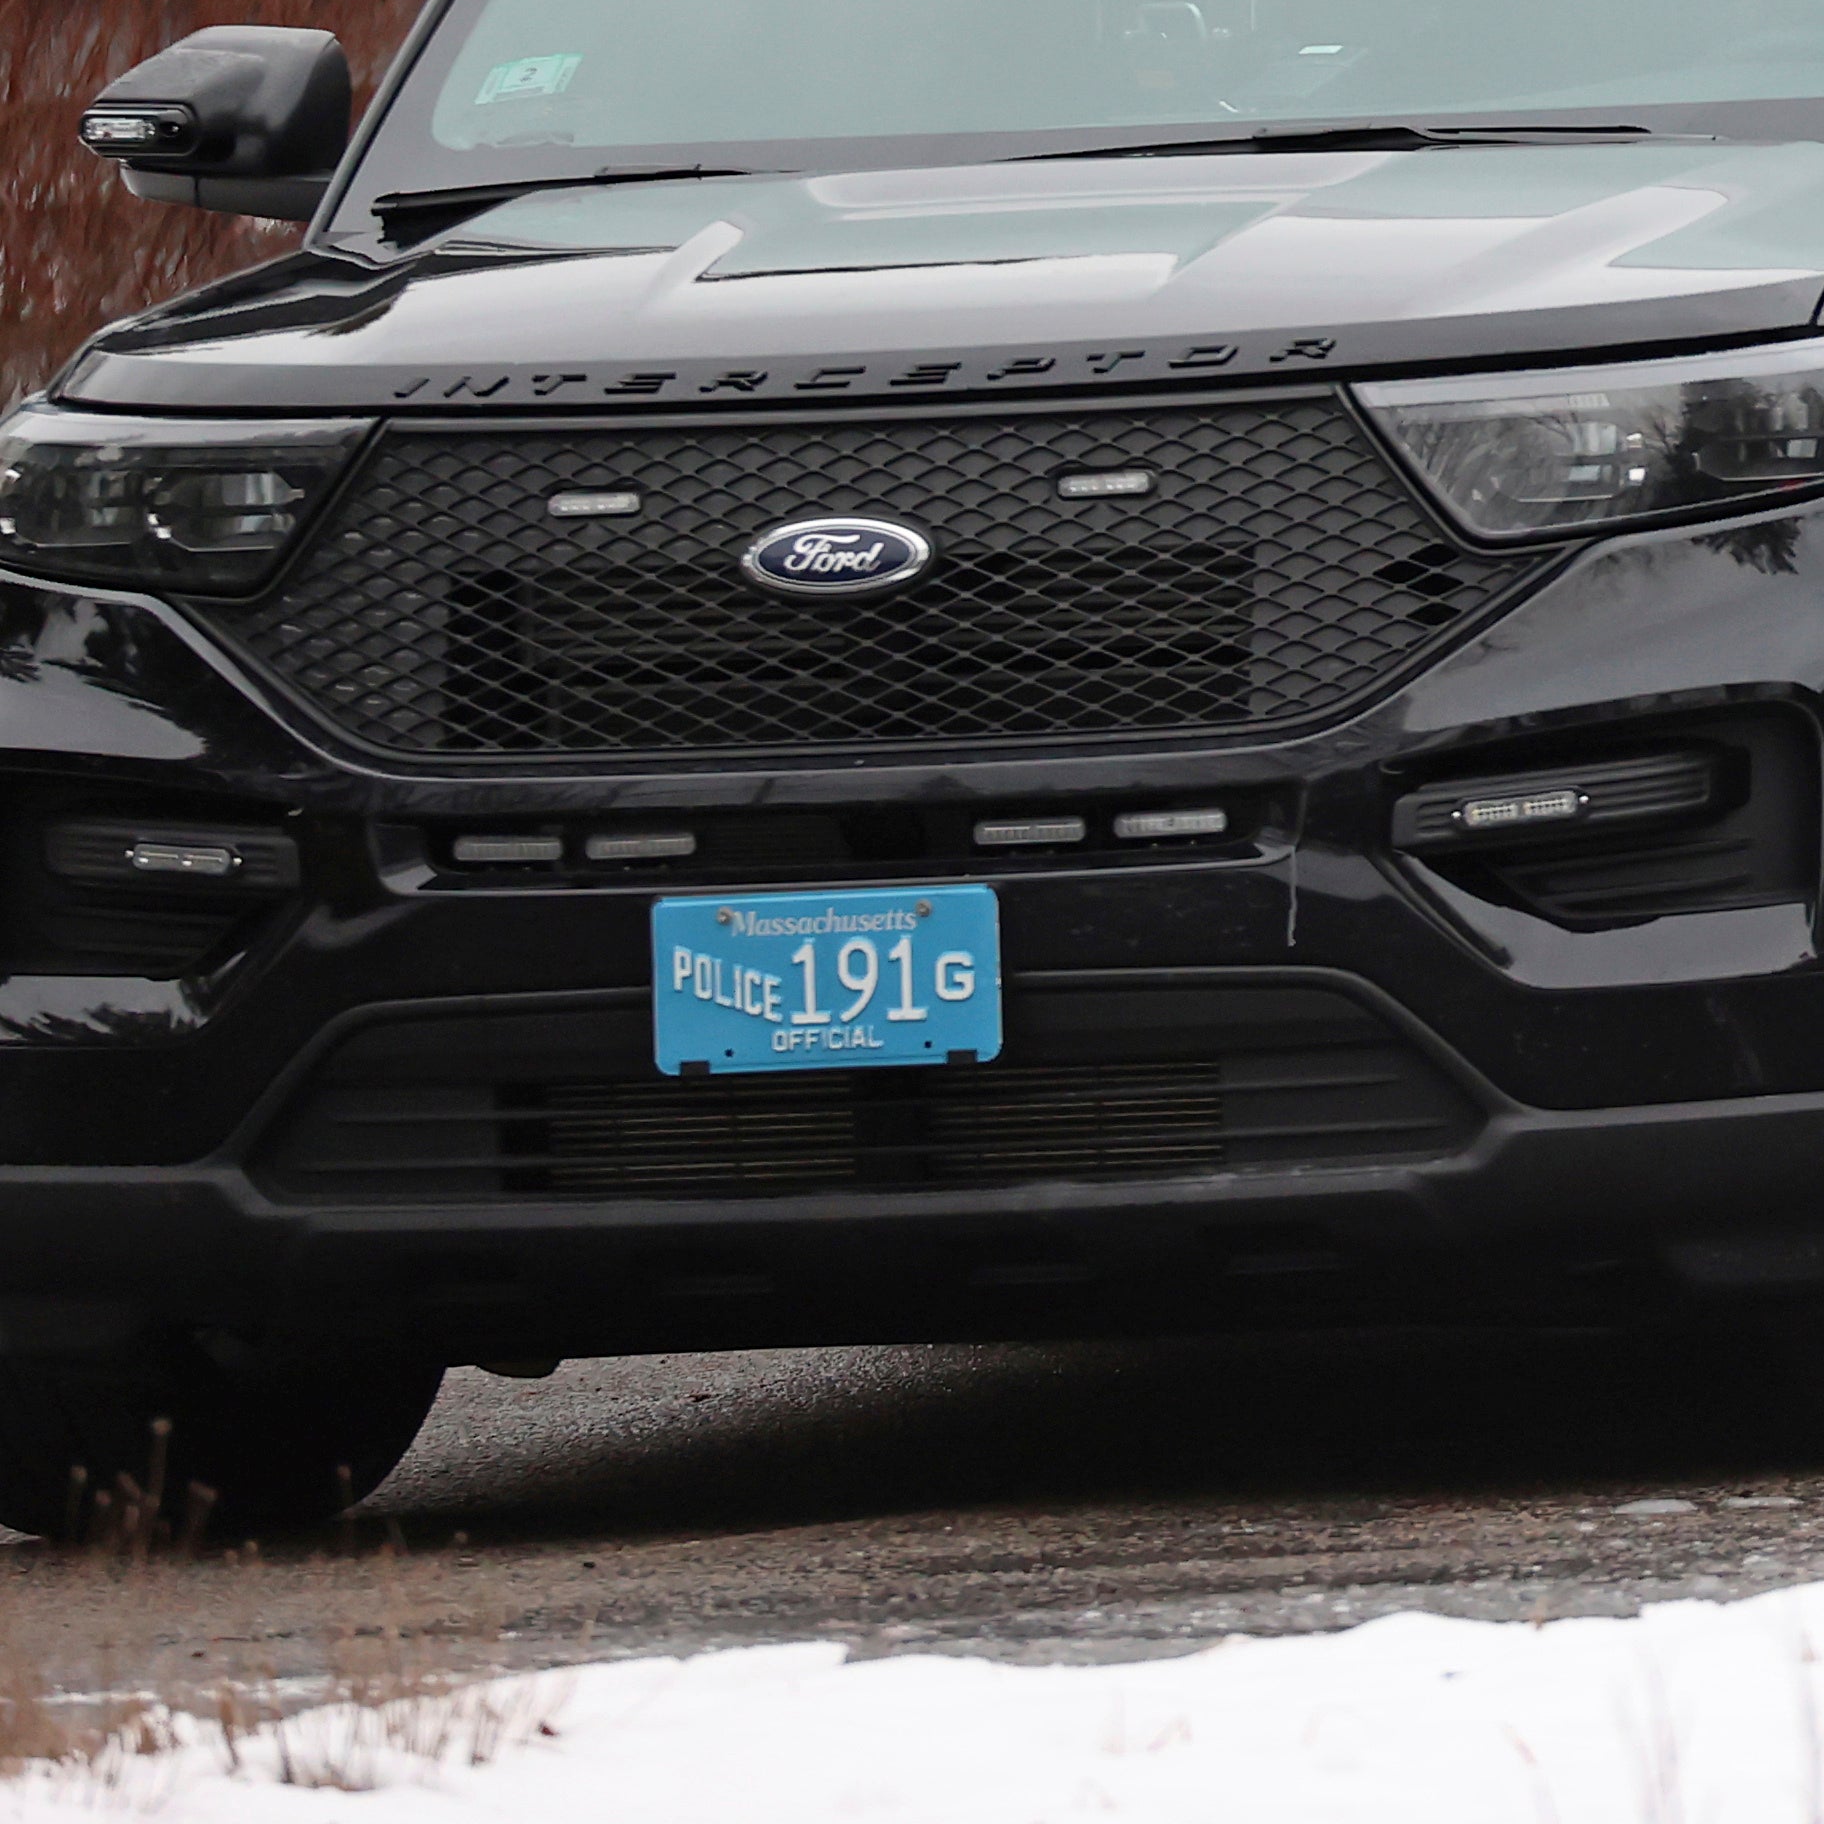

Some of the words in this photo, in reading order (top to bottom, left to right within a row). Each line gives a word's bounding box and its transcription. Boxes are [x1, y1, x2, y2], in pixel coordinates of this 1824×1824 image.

[393, 336, 1338, 398] INTERCEPTOR
[783, 533, 885, 573] Ford
[731, 907, 918, 937] Massachusetts
[673, 945, 784, 1023] POLICE
[771, 1026, 885, 1052] OFFICIAL
